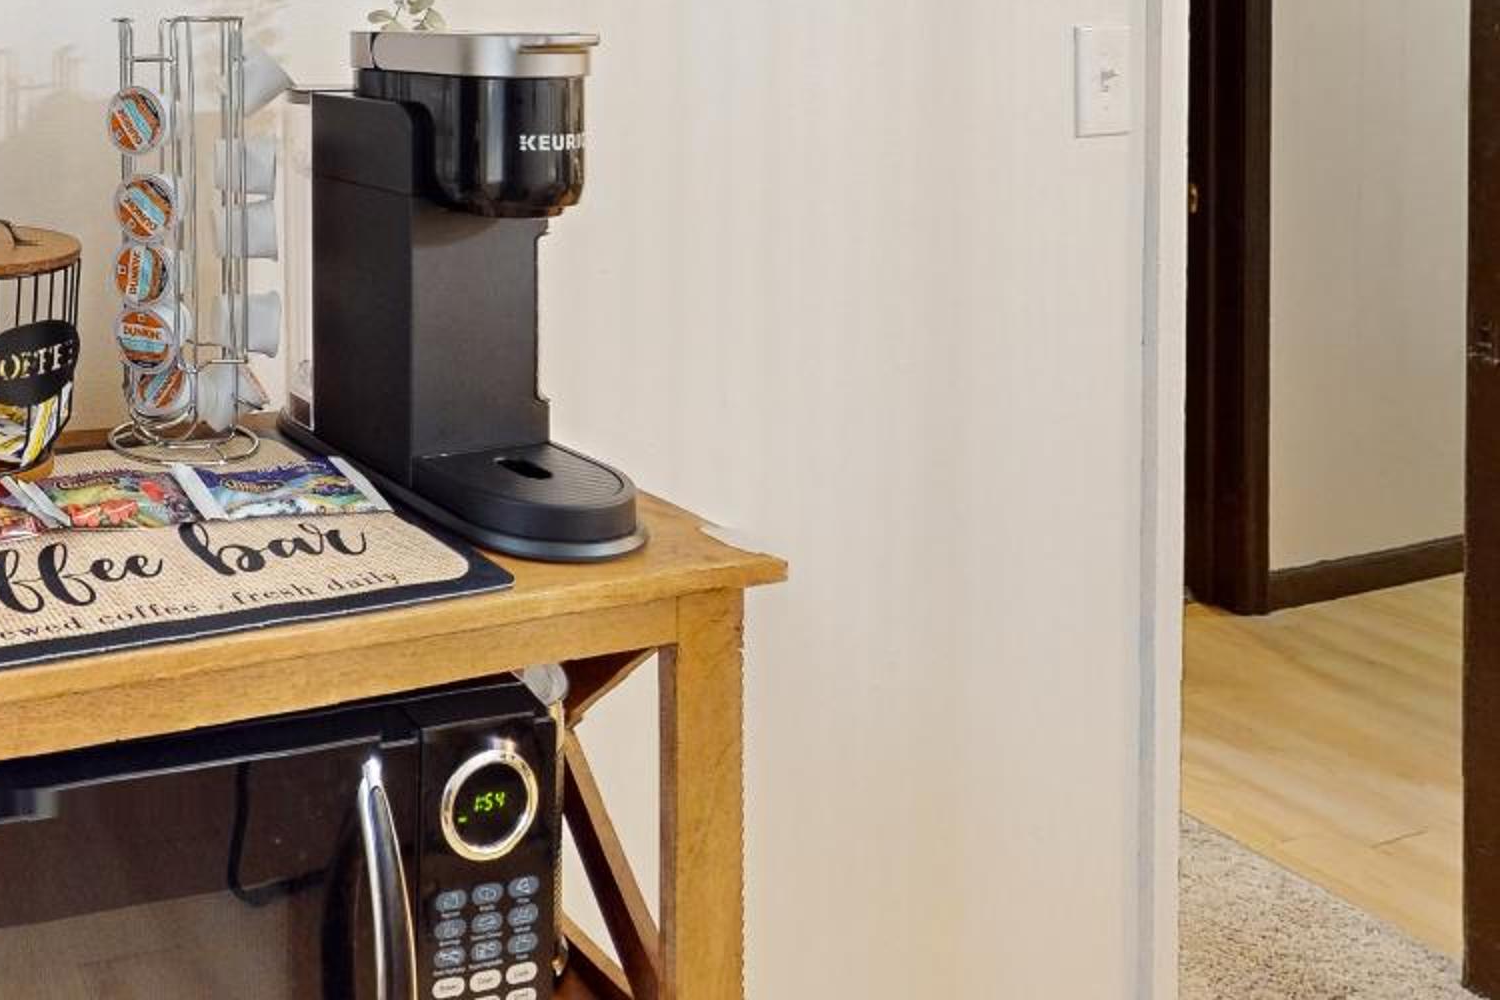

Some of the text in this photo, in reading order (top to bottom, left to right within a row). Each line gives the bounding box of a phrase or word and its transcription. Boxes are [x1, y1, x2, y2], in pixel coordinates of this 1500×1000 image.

[179, 522, 367, 576] bar
[96, 600, 198, 628] coffee
[231, 584, 316, 606] fresh
[326, 570, 401, 593] daily
[474, 791, 505, 812] 1:54
